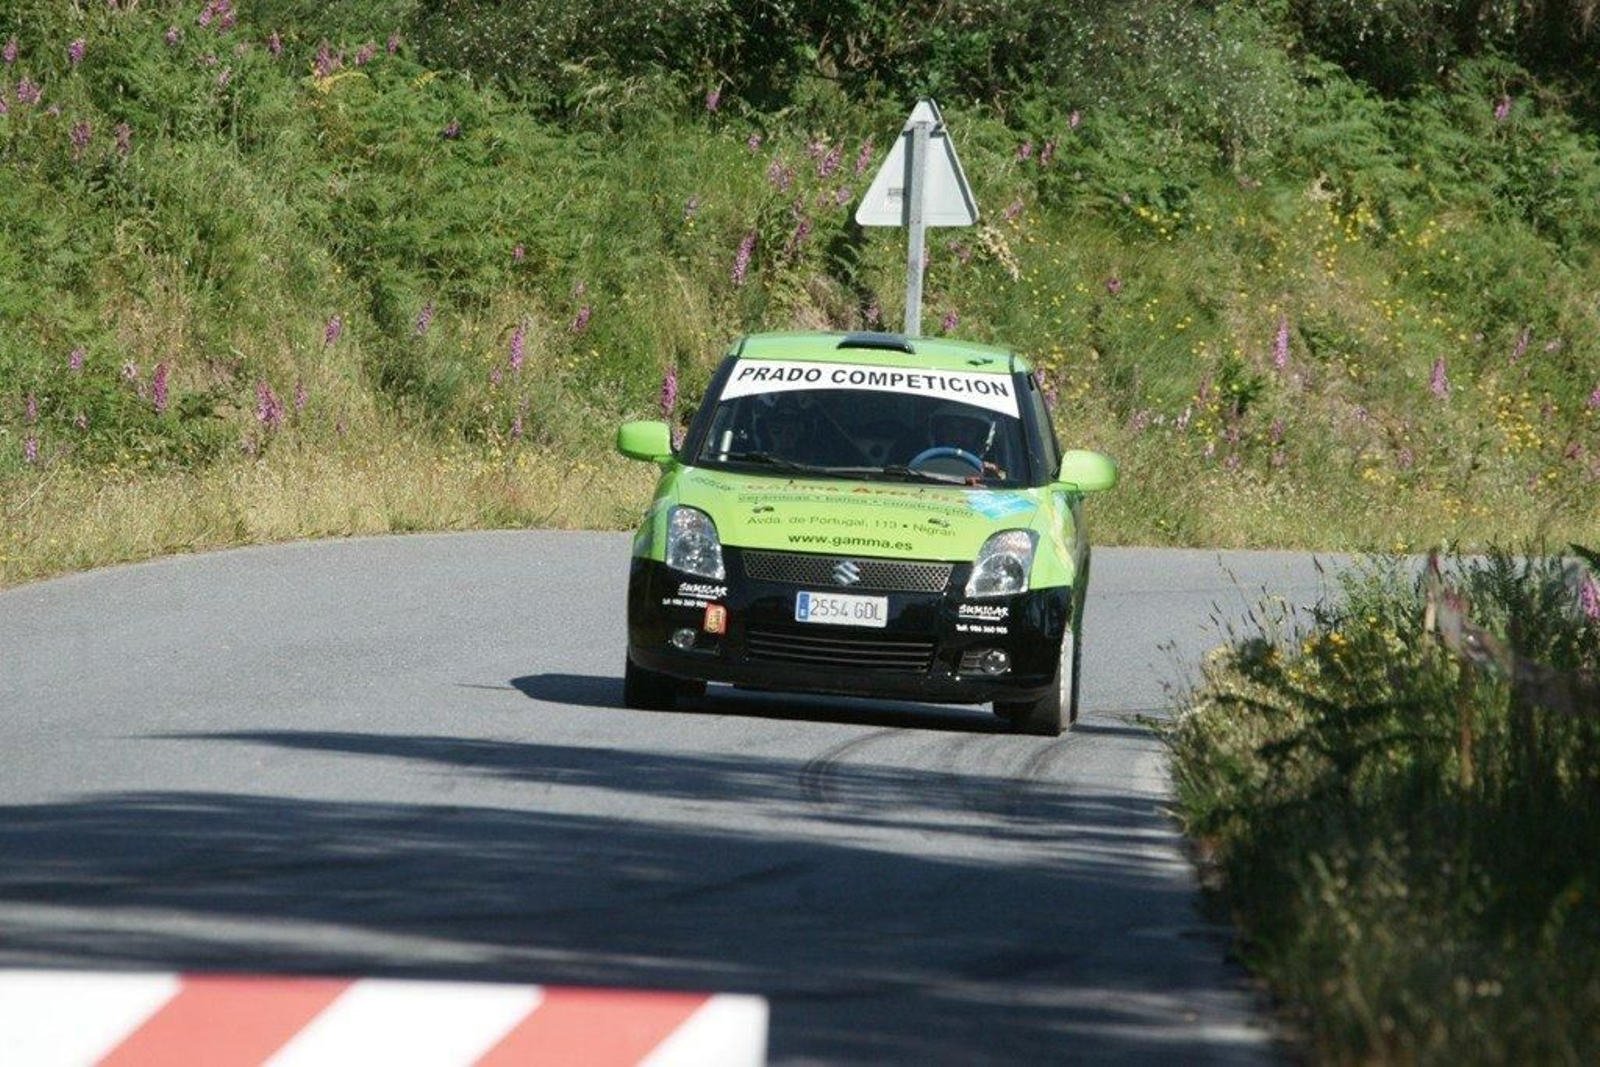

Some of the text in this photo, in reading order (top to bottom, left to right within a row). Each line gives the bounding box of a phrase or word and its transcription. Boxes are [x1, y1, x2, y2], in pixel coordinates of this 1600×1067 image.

[737, 366, 1010, 398] PRADO COMPETICION
[789, 516, 806, 526] de
[787, 533, 914, 552] www.gamma.es
[810, 599, 848, 616] 2554
[854, 602, 883, 620] GDL
